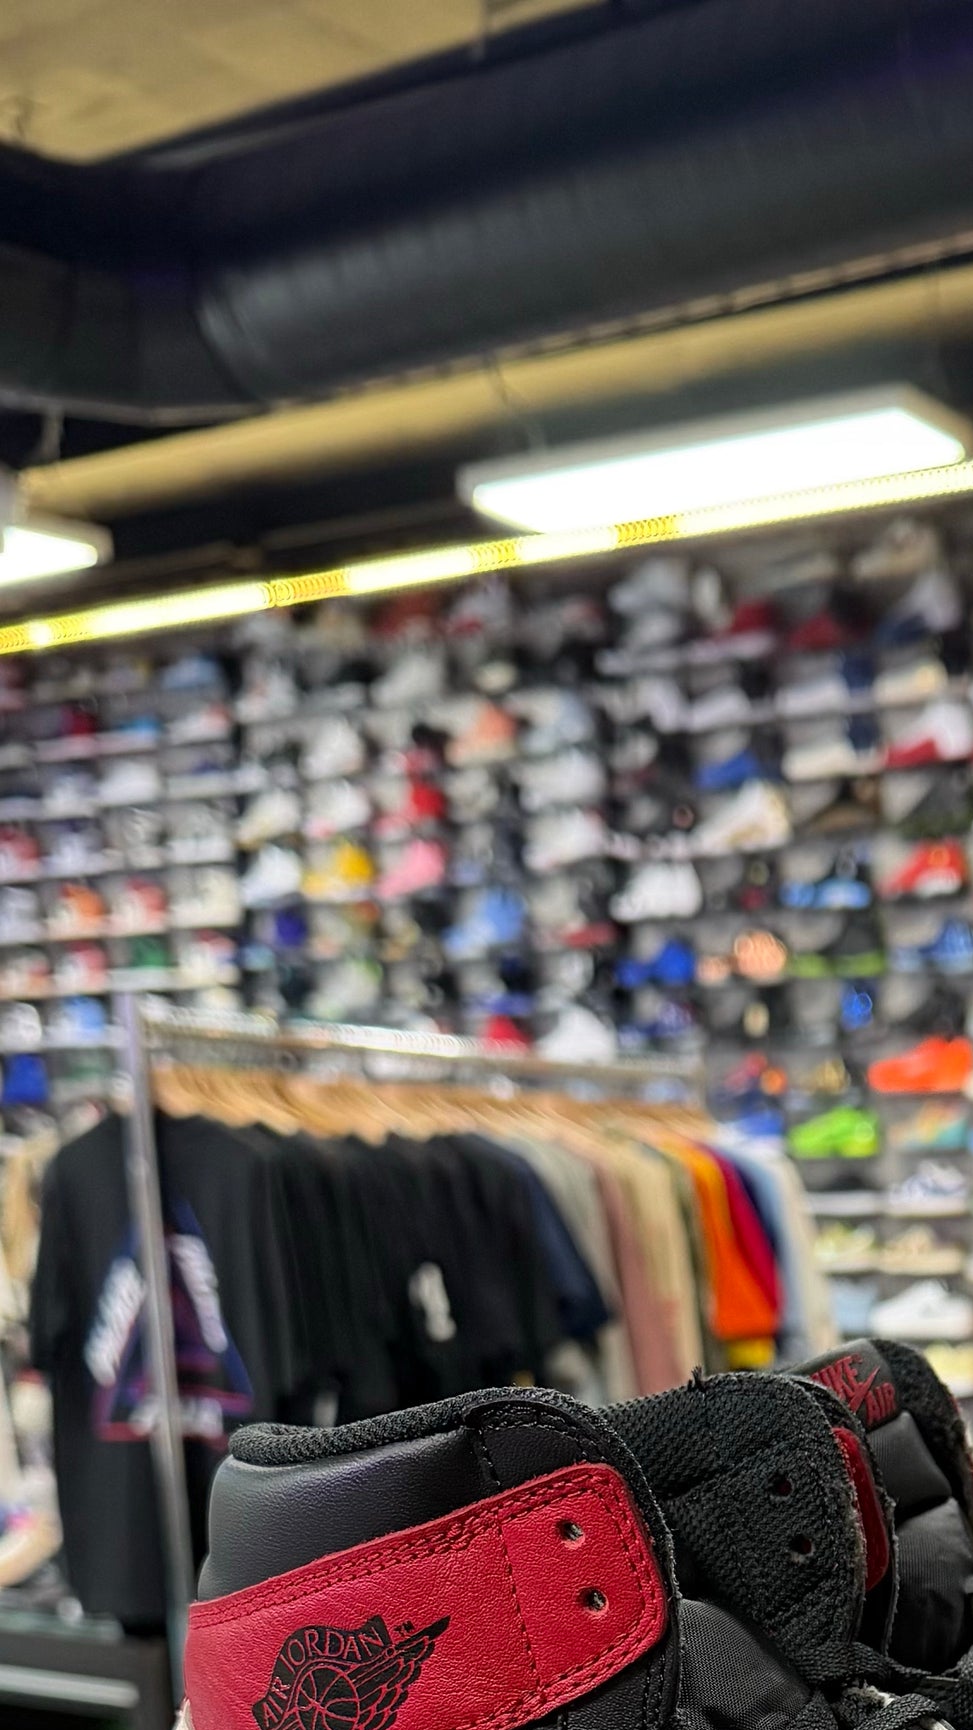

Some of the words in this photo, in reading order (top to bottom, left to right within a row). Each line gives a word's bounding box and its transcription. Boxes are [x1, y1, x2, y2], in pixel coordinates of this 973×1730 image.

[811, 1354, 866, 1400] IKE
[865, 1382, 897, 1428] AIR
[262, 1676, 291, 1728] AIR
[279, 1627, 385, 1675] JORDAN
